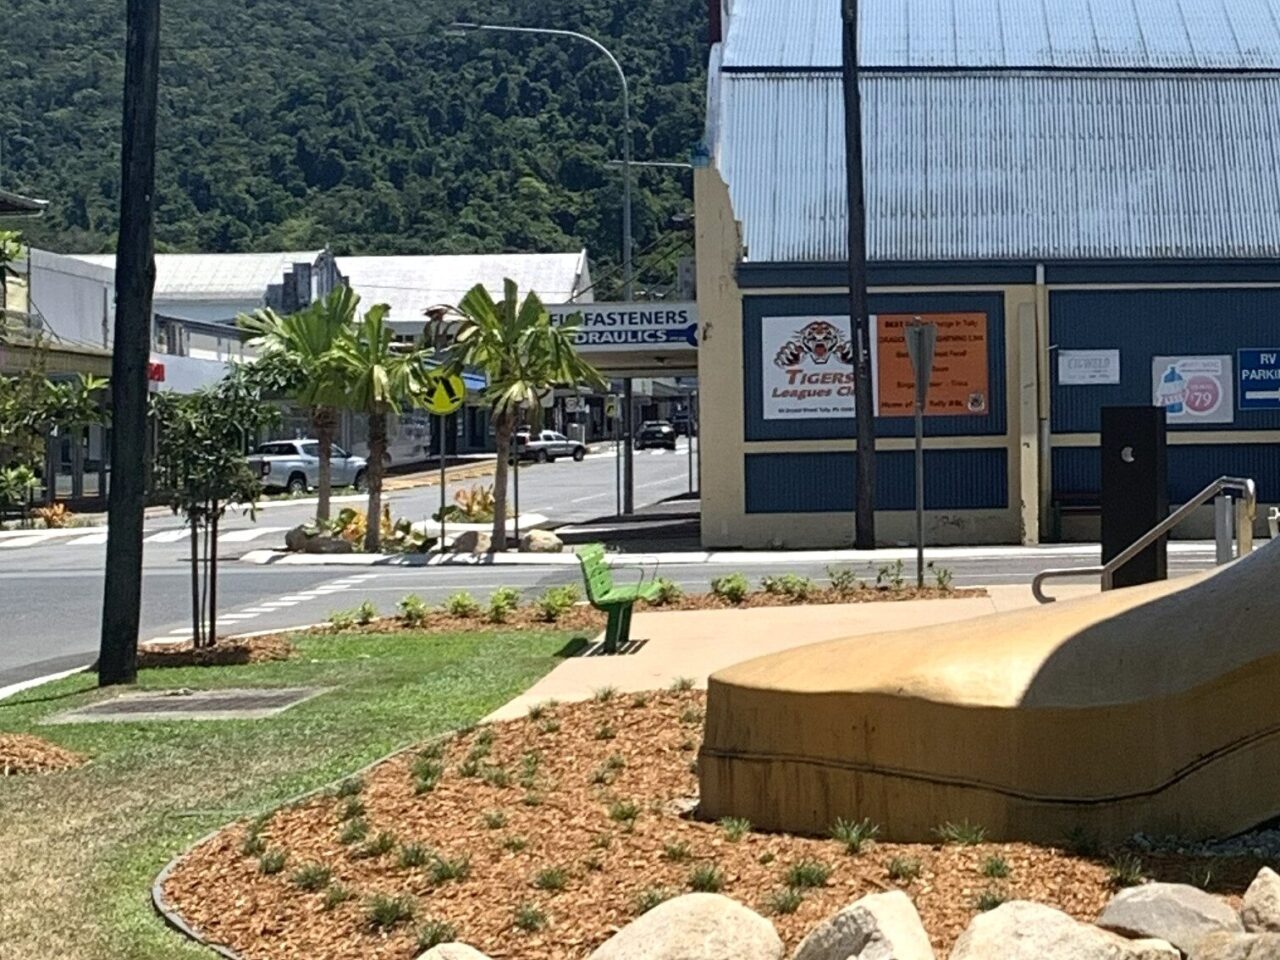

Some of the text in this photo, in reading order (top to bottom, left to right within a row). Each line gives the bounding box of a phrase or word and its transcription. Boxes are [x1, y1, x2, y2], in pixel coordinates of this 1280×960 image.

[584, 309, 688, 326] FASTENERS
[1260, 353, 1277, 365] RV
[772, 386, 832, 401] Leagues
